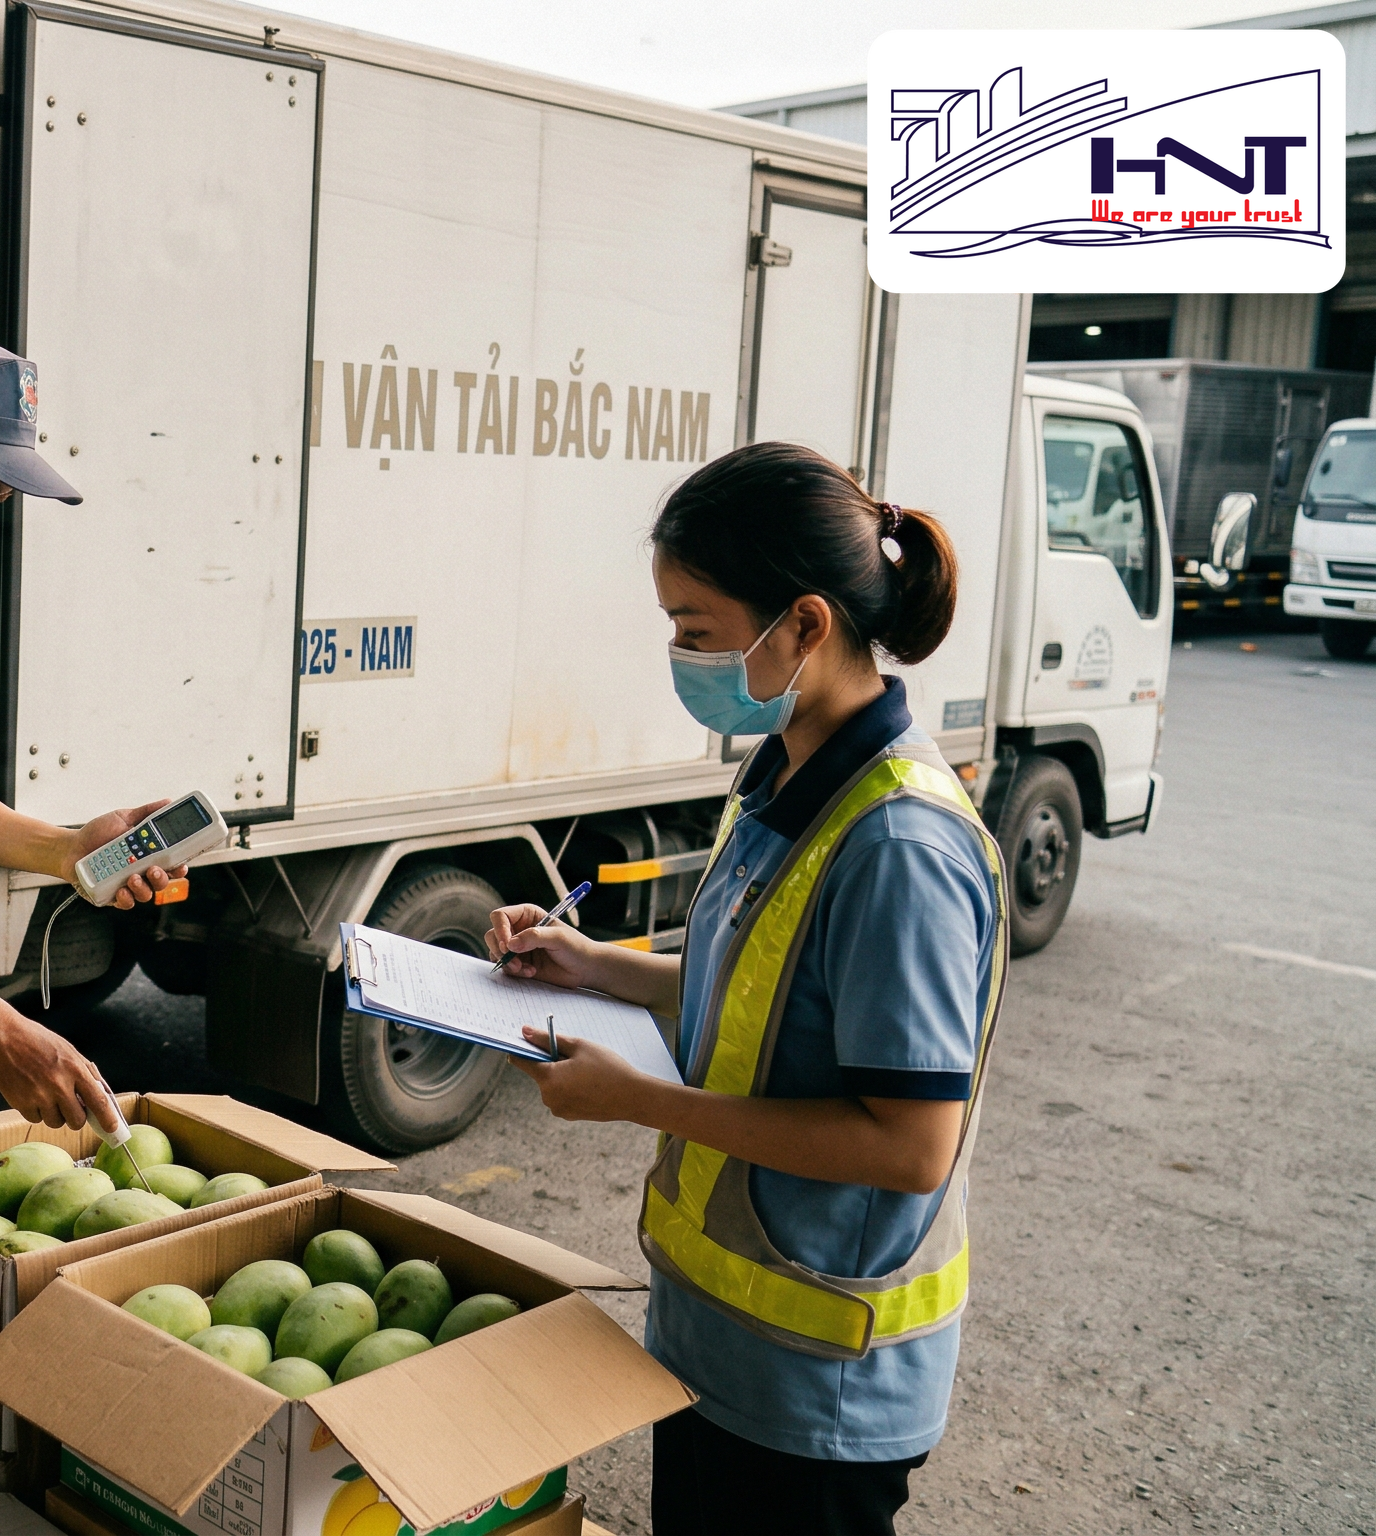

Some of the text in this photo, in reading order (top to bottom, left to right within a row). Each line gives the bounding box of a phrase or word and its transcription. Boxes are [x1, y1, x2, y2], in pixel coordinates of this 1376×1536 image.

[342, 344, 439, 471] VẬN
[453, 342, 520, 456] TẢI
[532, 348, 613, 460] BẮC
[624, 385, 712, 463] NAM
[360, 625, 413, 672] NAM
